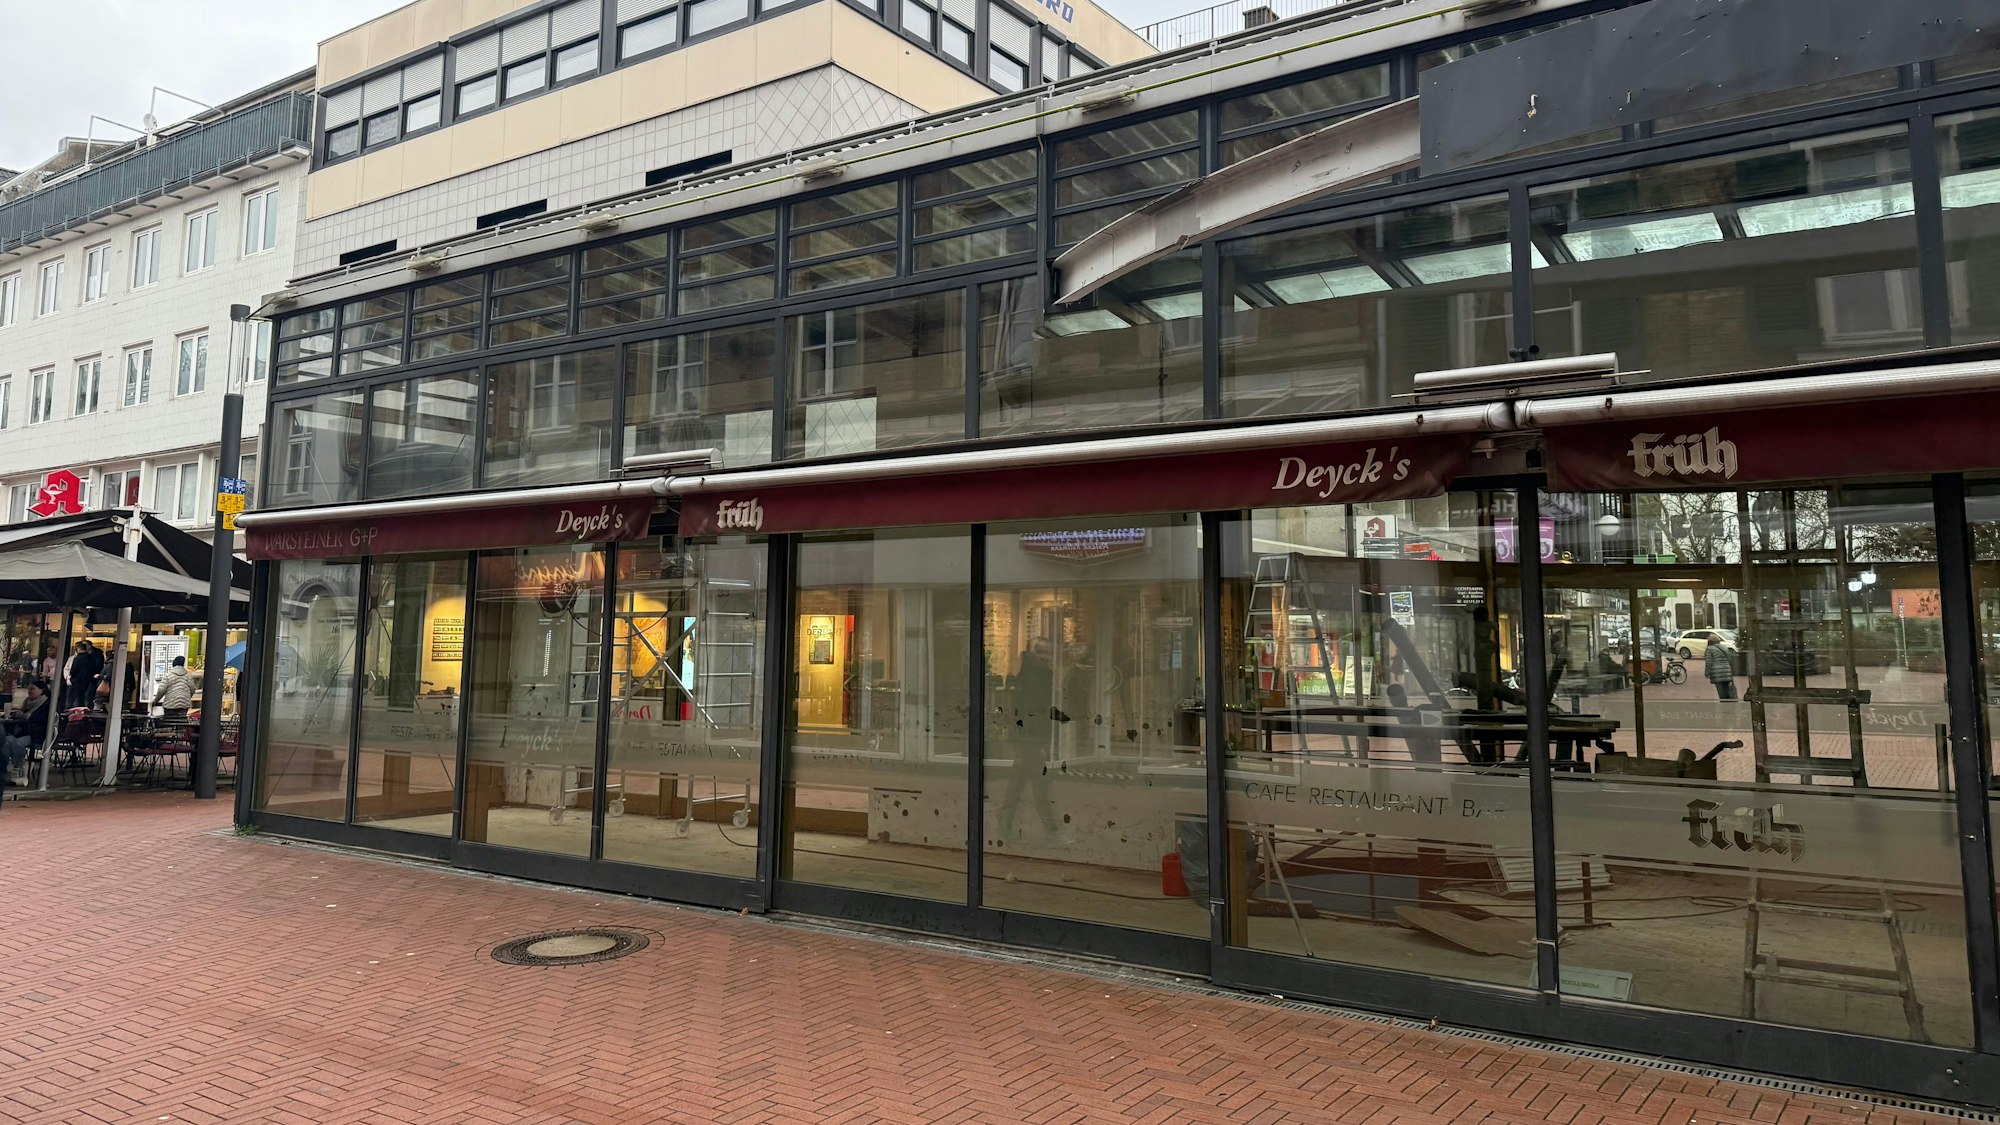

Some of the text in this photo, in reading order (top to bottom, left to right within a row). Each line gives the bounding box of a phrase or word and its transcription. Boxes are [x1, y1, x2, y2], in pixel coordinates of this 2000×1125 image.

[1036, 0, 1074, 24] RO
[1272, 446, 1412, 499] Deyck's
[265, 526, 378, 551] WARSTEINER G+P
[555, 504, 624, 540] Deyck's
[1245, 781, 1297, 803] CAFE
[1308, 787, 1449, 817] RESTAURANT
